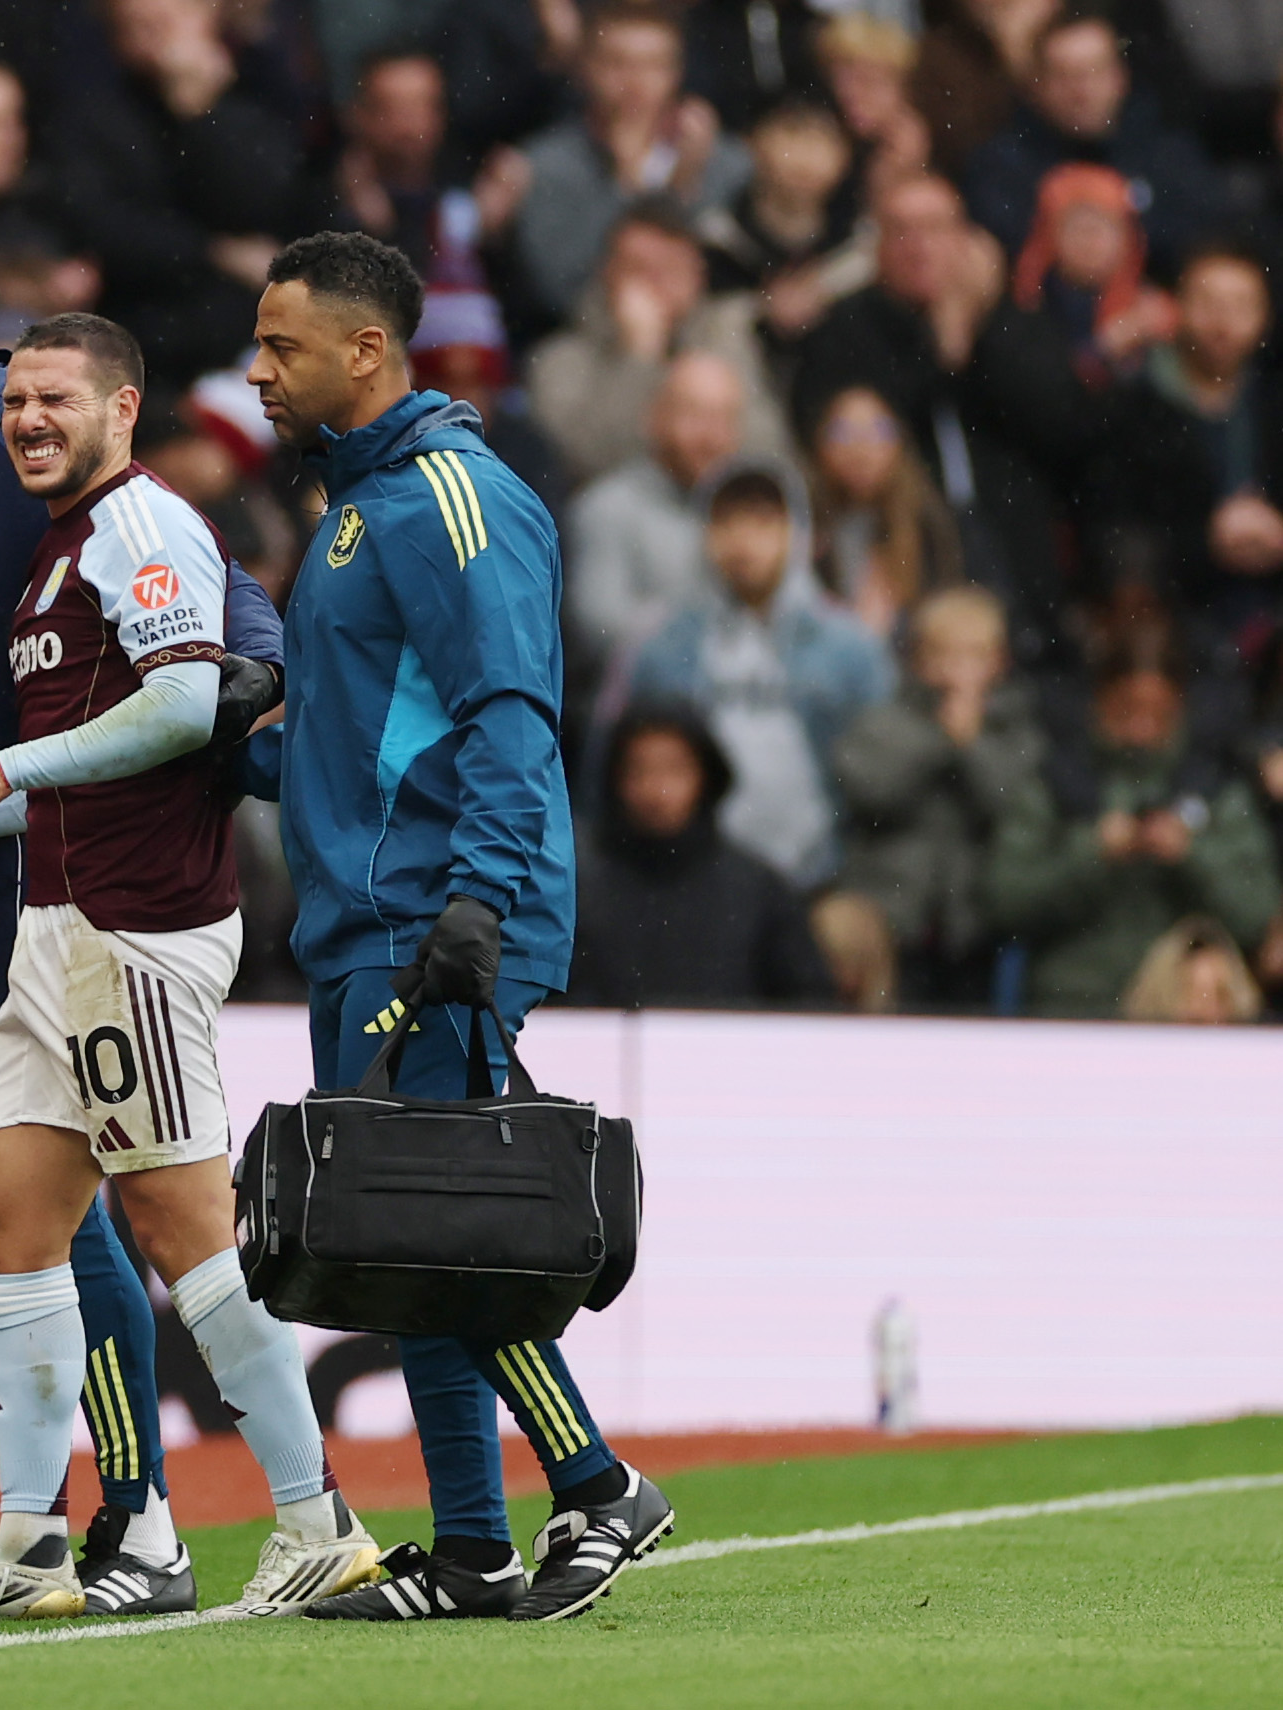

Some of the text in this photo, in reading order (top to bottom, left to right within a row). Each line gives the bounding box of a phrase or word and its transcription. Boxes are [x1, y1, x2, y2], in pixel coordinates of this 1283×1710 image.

[130, 607, 199, 635] TRADE
[138, 621, 204, 647] NATION
[8, 630, 63, 684] tano
[66, 1025, 138, 1109] 10
